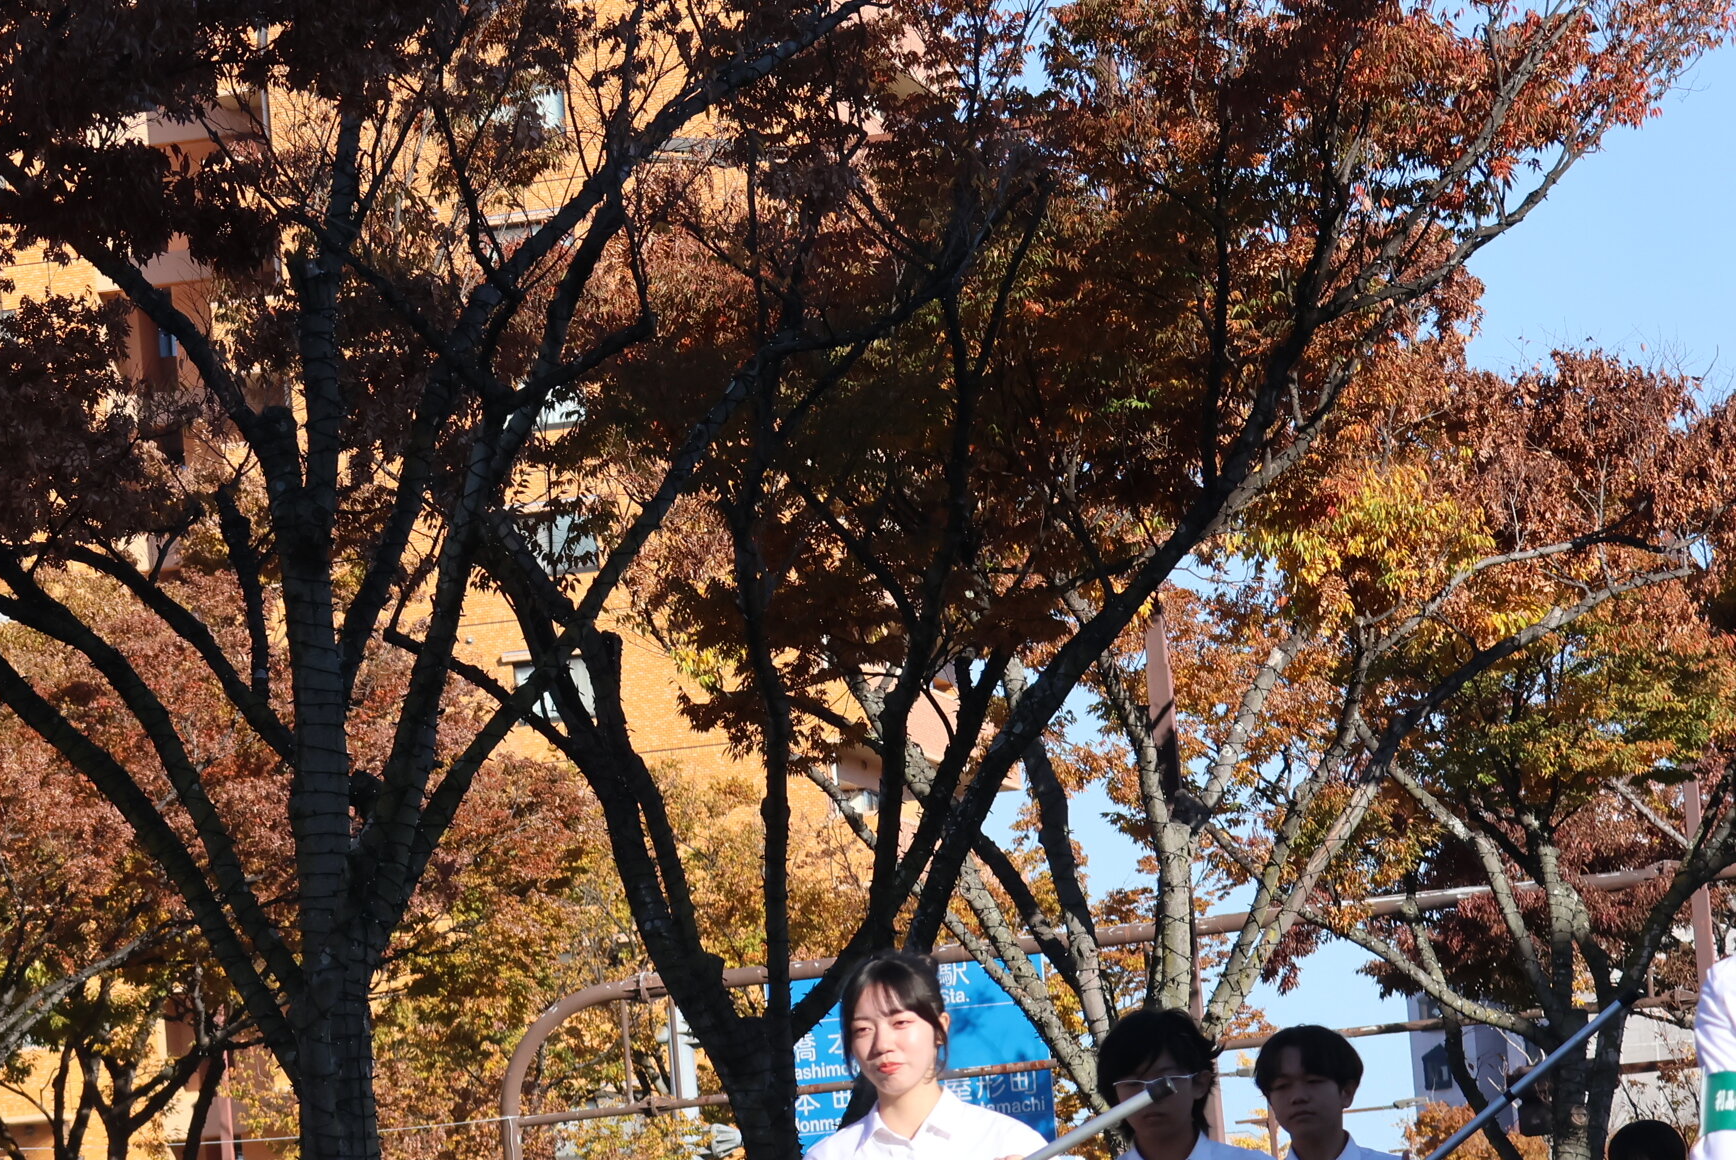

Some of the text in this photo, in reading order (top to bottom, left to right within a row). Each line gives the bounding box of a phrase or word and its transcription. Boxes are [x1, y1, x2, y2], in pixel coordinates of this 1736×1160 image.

[938, 962, 970, 987] 駅
[940, 988, 970, 1005] Sta.
[979, 1095, 1046, 1114] tamachi
